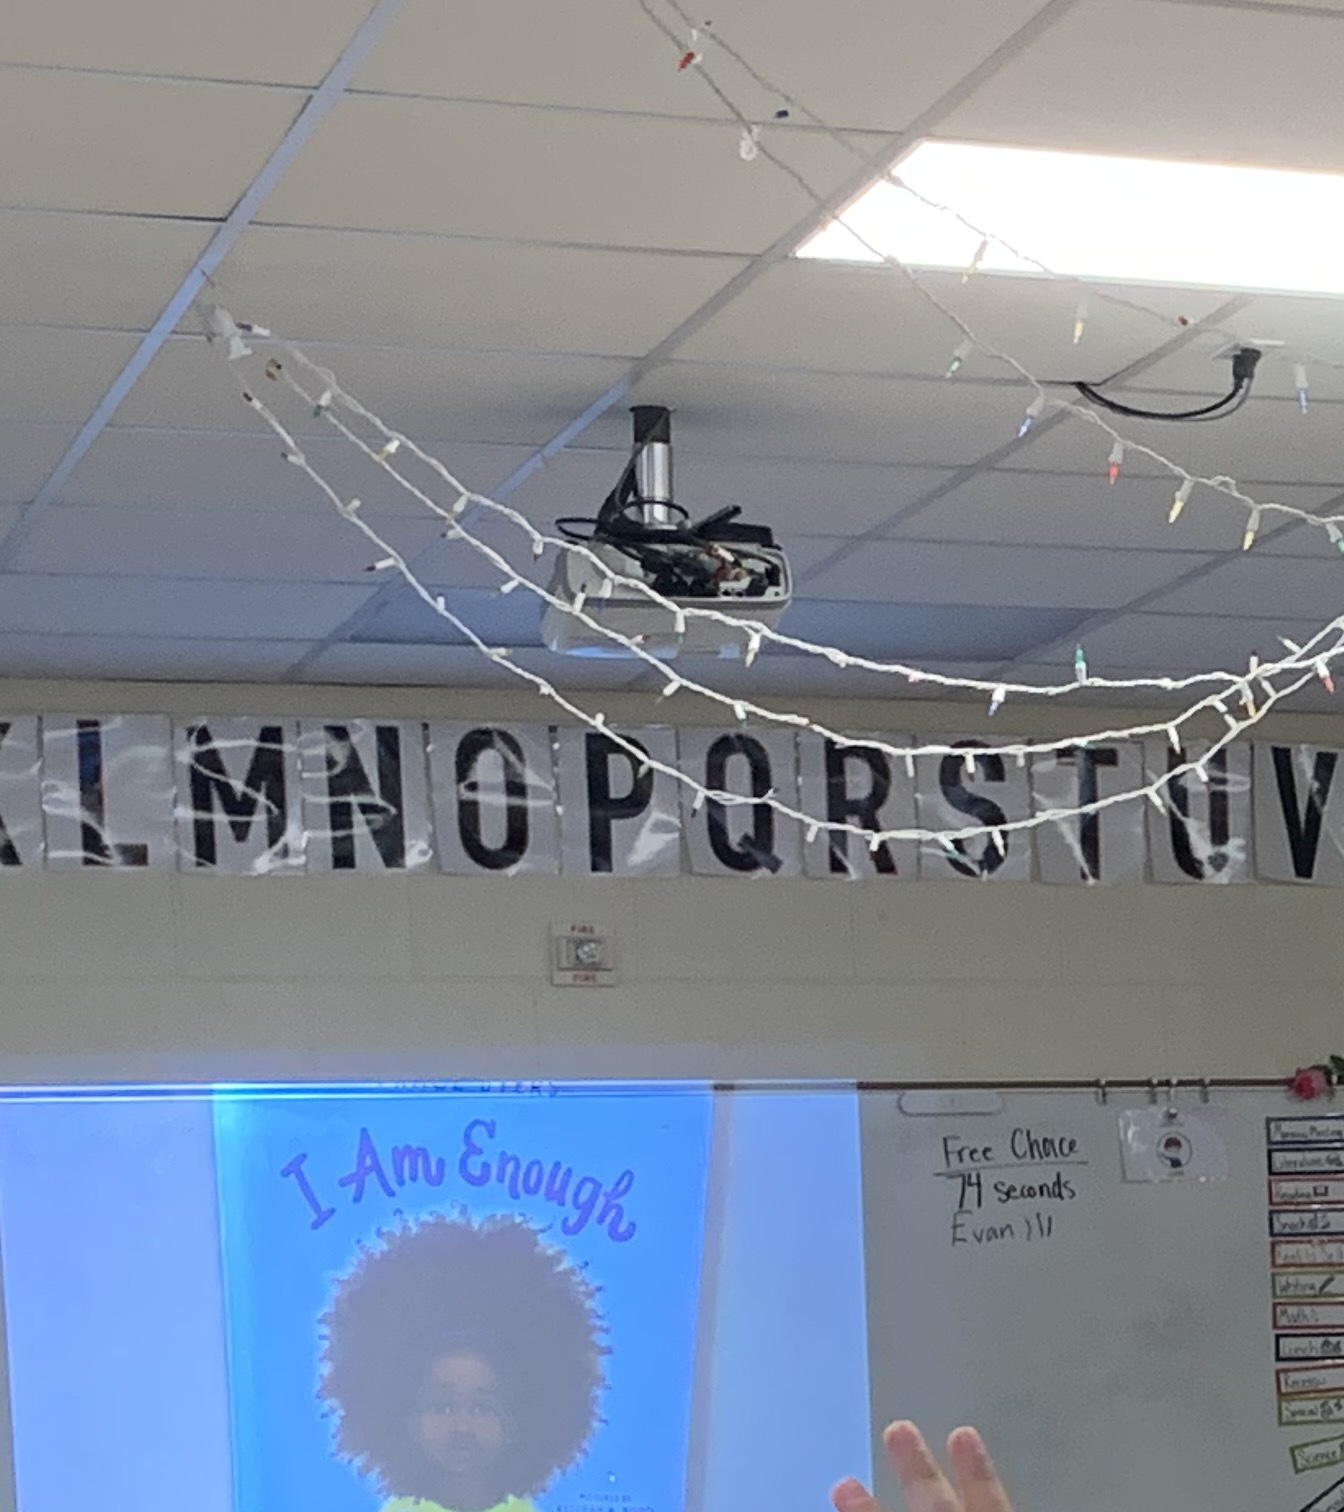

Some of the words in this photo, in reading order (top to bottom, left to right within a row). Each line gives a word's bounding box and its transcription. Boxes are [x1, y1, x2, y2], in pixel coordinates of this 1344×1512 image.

[77, 720, 149, 867] L
[187, 725, 288, 868] M
[323, 725, 407, 870] N
[455, 725, 529, 870] O
[585, 732, 656, 873] P
[704, 734, 785, 874] Q
[823, 737, 896, 876] R
[938, 743, 1007, 879] S
[1056, 744, 1119, 882] T
[1165, 745, 1234, 880] U
[1270, 746, 1338, 882] V
[942, 1135, 994, 1168] Free
[281, 1152, 336, 1230] I
[338, 1127, 446, 1203] Am
[458, 1118, 637, 1243] Enough
[993, 1171, 1077, 1204] seconds
[952, 1210, 1015, 1247] Evan
